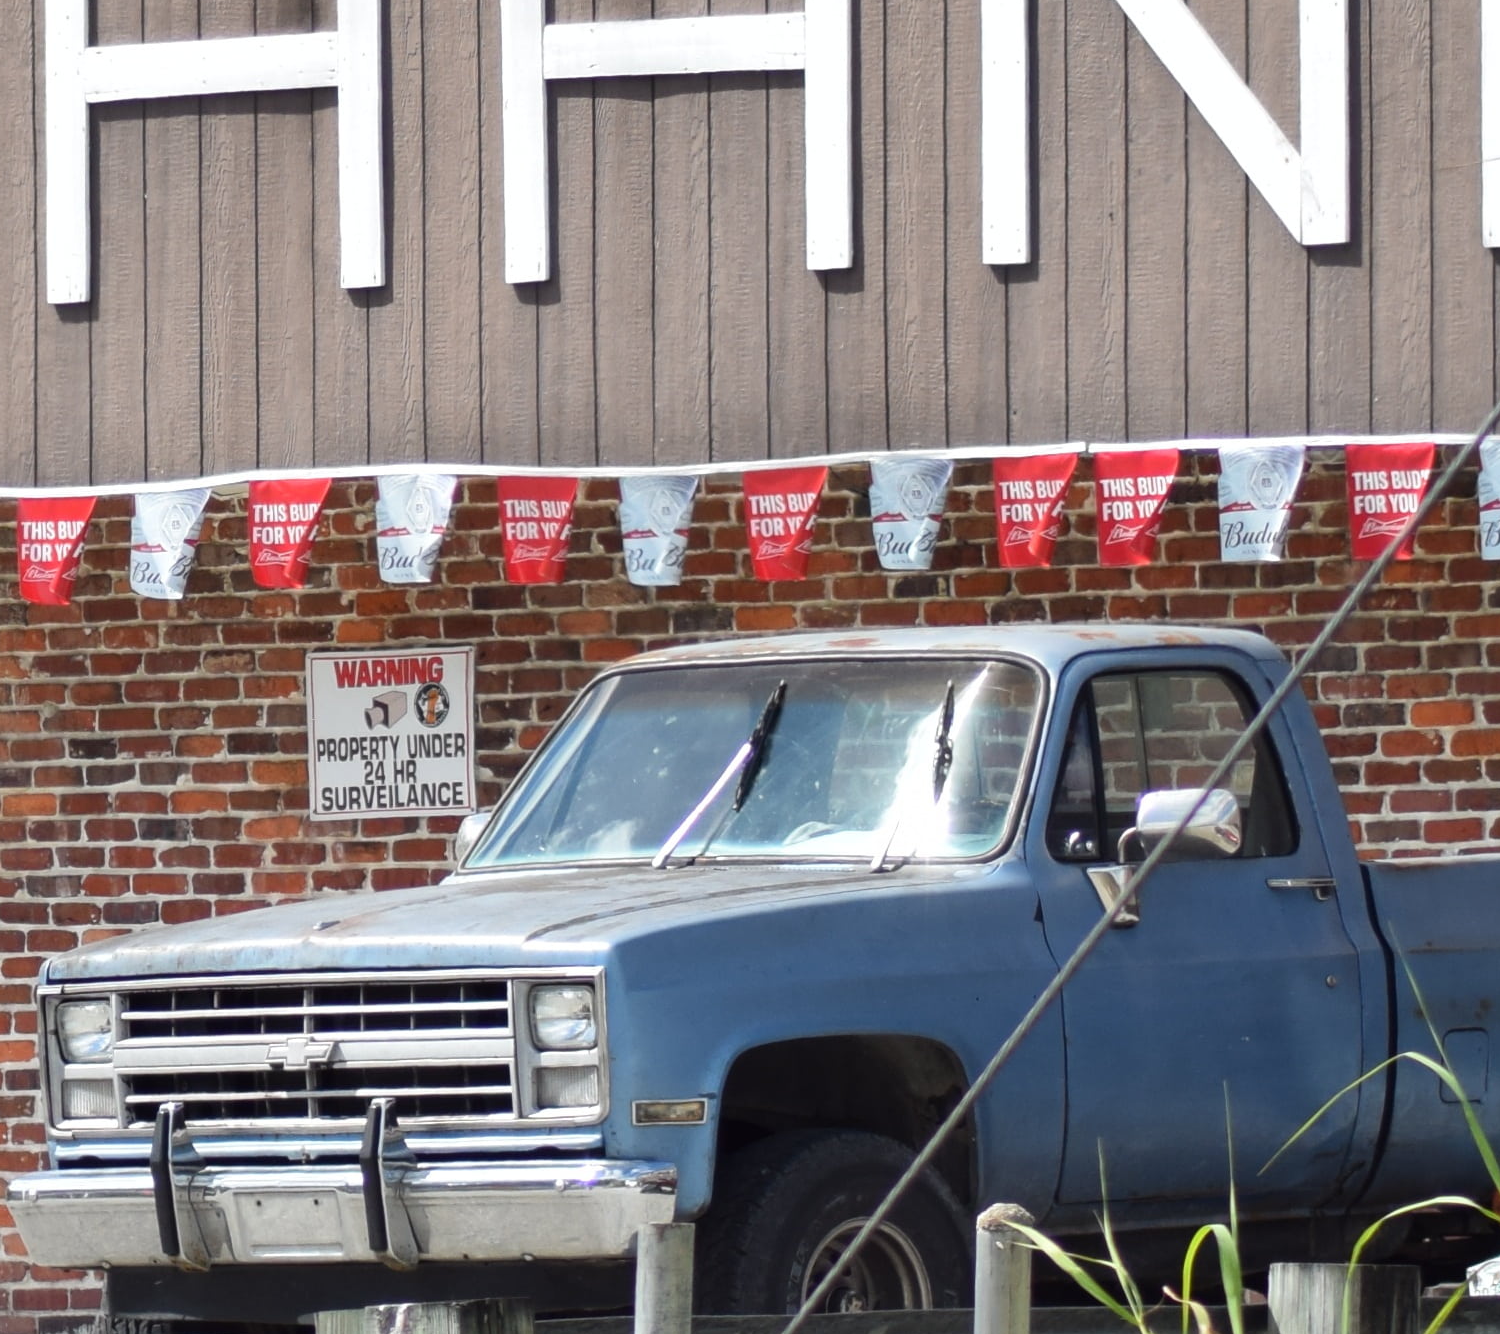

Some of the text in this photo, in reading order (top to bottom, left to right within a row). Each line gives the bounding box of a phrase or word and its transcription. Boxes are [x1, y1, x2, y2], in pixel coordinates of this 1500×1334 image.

[999, 480, 1034, 500] THIS
[1099, 478, 1135, 498] THIS
[1352, 471, 1388, 491] THIS
[252, 505, 287, 523] THIS
[503, 499, 539, 518] THIS
[748, 494, 785, 515] THIS
[1000, 504, 1033, 524] FOR
[1102, 501, 1135, 522] FOR
[1354, 495, 1387, 515] FOR
[20, 521, 55, 540] THIS
[252, 526, 285, 544] FOR
[505, 522, 539, 540] FOR
[750, 517, 784, 538] FOR
[21, 543, 52, 562] FOR
[334, 656, 443, 688] WARNING
[317, 733, 466, 762] PROPERTY UNDER
[364, 759, 417, 785] 24 HR
[321, 782, 464, 811] SURVEILANCE
